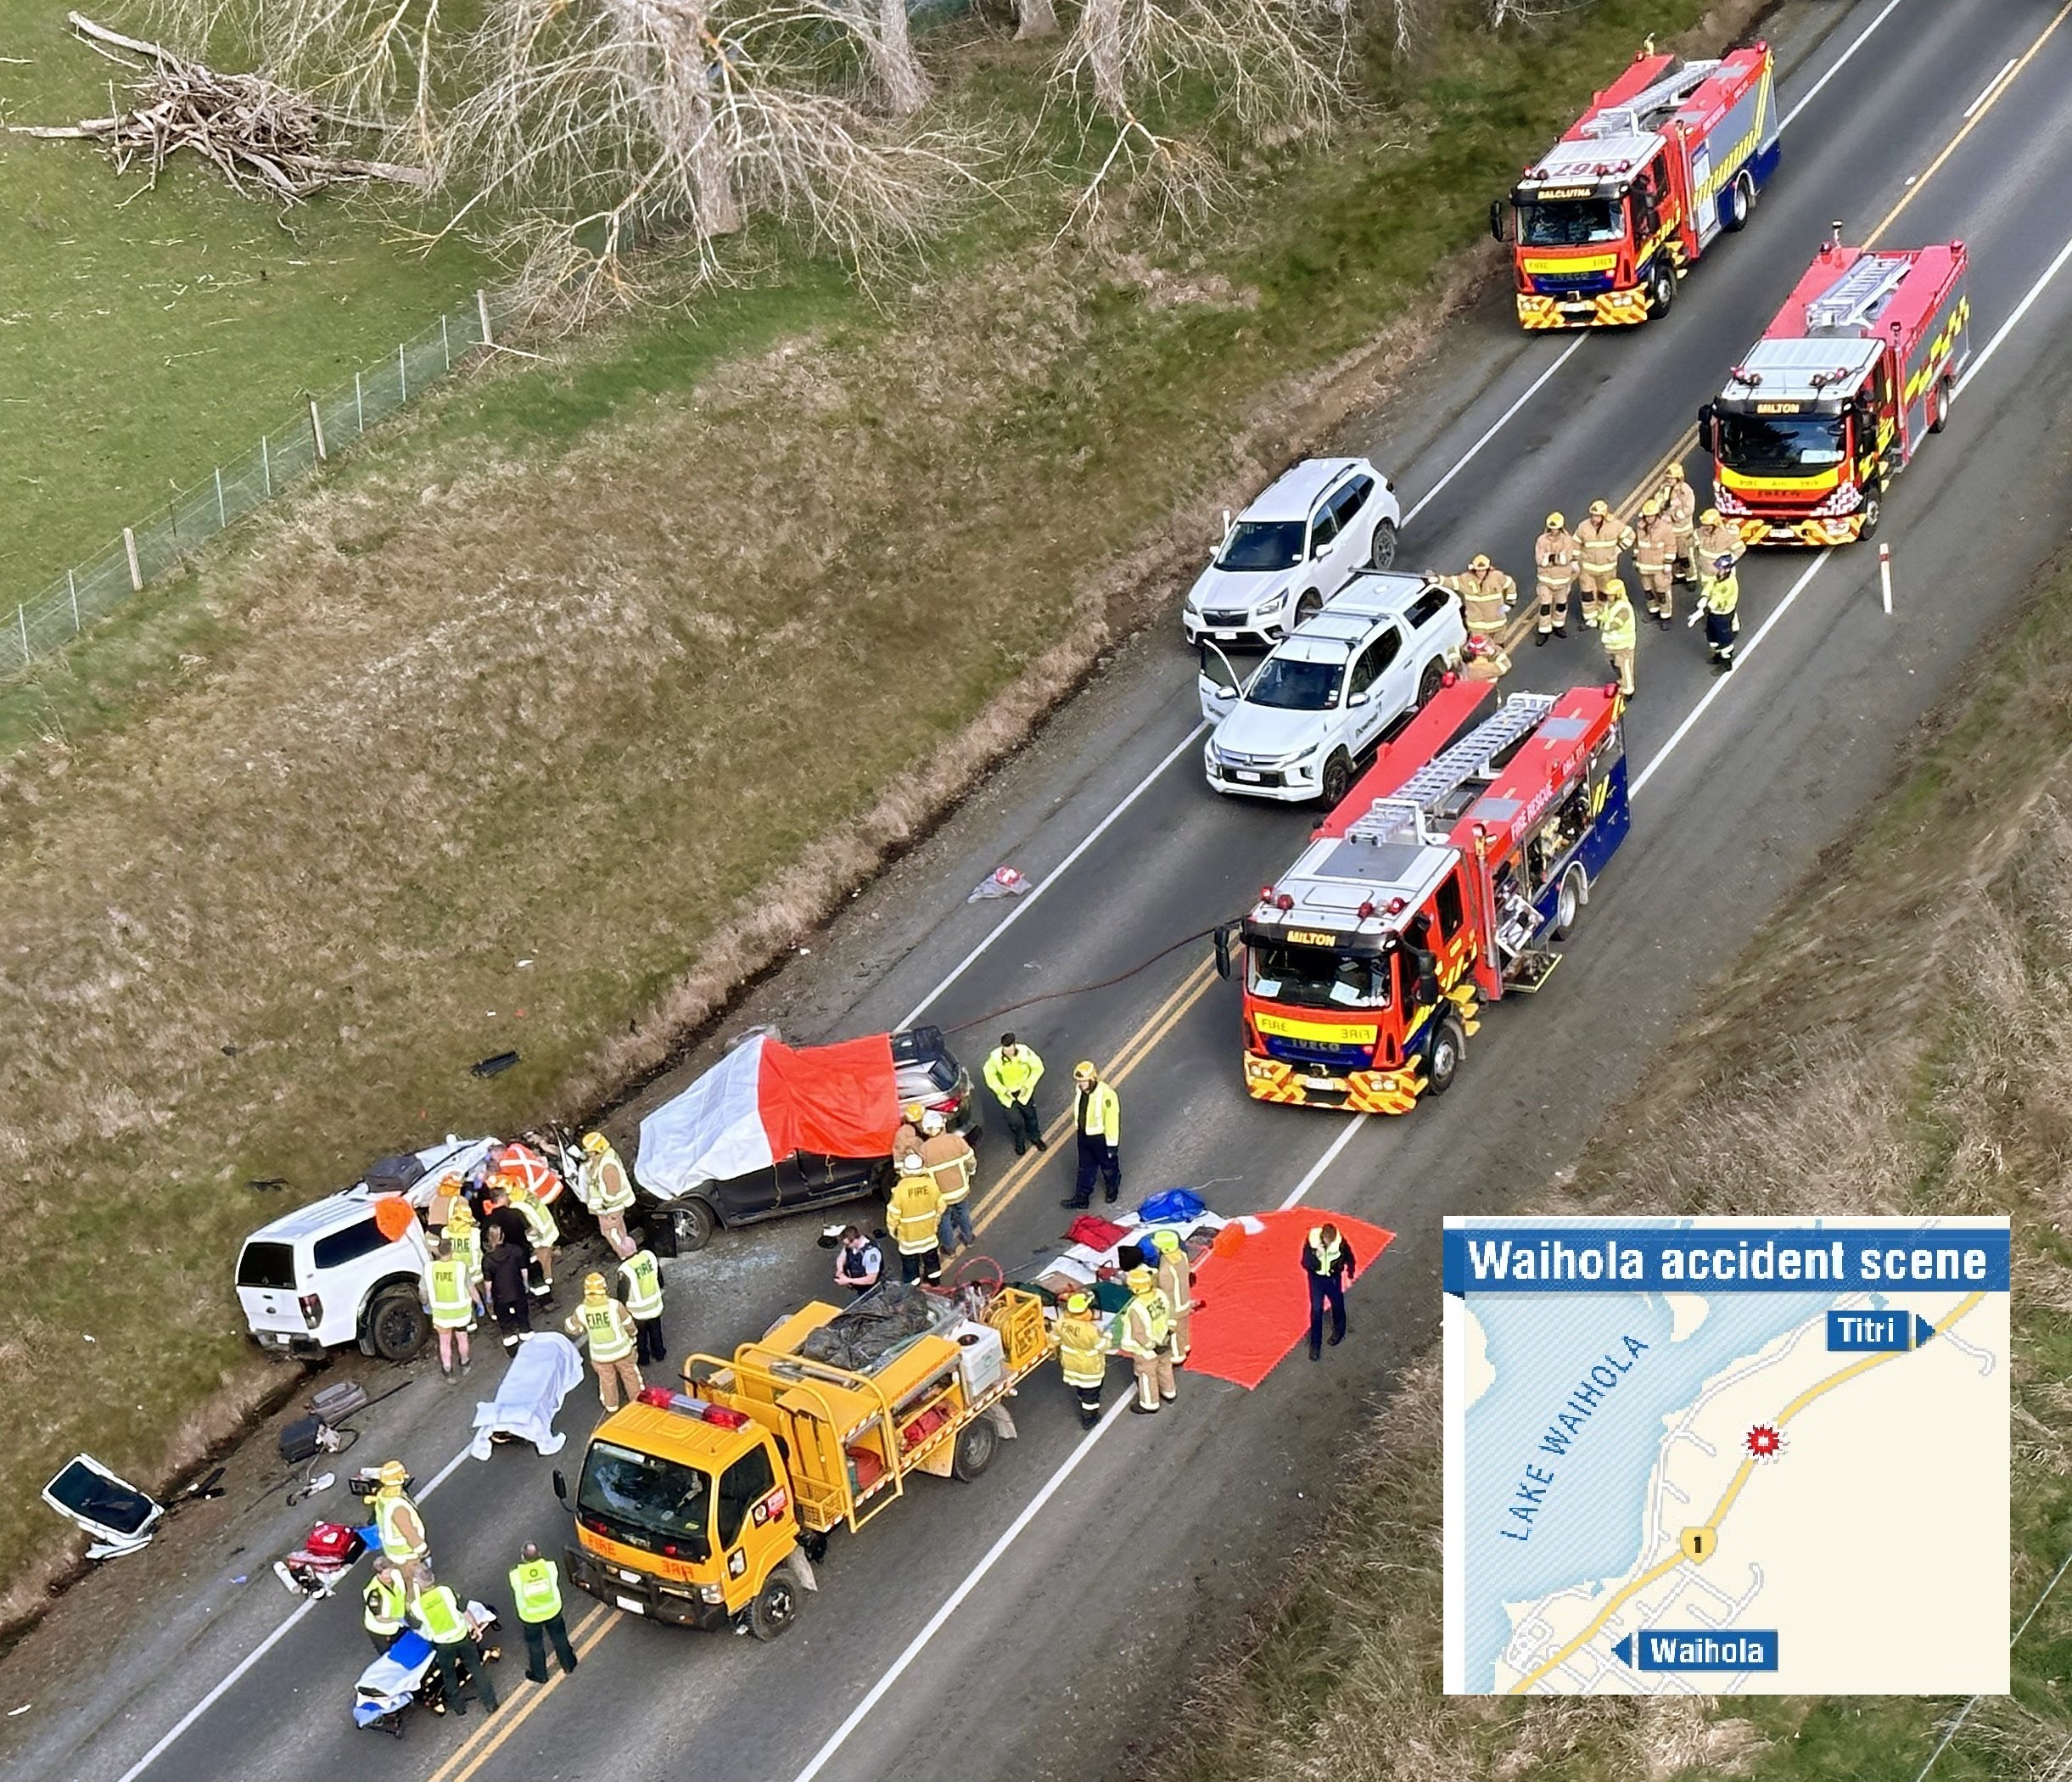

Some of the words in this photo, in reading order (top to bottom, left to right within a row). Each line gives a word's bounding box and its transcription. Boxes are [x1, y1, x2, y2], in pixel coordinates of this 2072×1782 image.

[1537, 188, 1591, 199] BALCLUTHA
[1756, 403, 1800, 414] MILTON
[1286, 930, 1336, 947] MILTON
[1261, 1018, 1288, 1032] FIRE
[1292, 1039, 1341, 1052] IVECO
[908, 1185, 930, 1198] FIRE
[635, 1258, 653, 1279] FIRE
[434, 1271, 453, 1281] FIRE
[585, 1311, 610, 1329] FIRE
[1061, 1322, 1081, 1337] FIRE
[587, 1534, 617, 1556] FIRE
